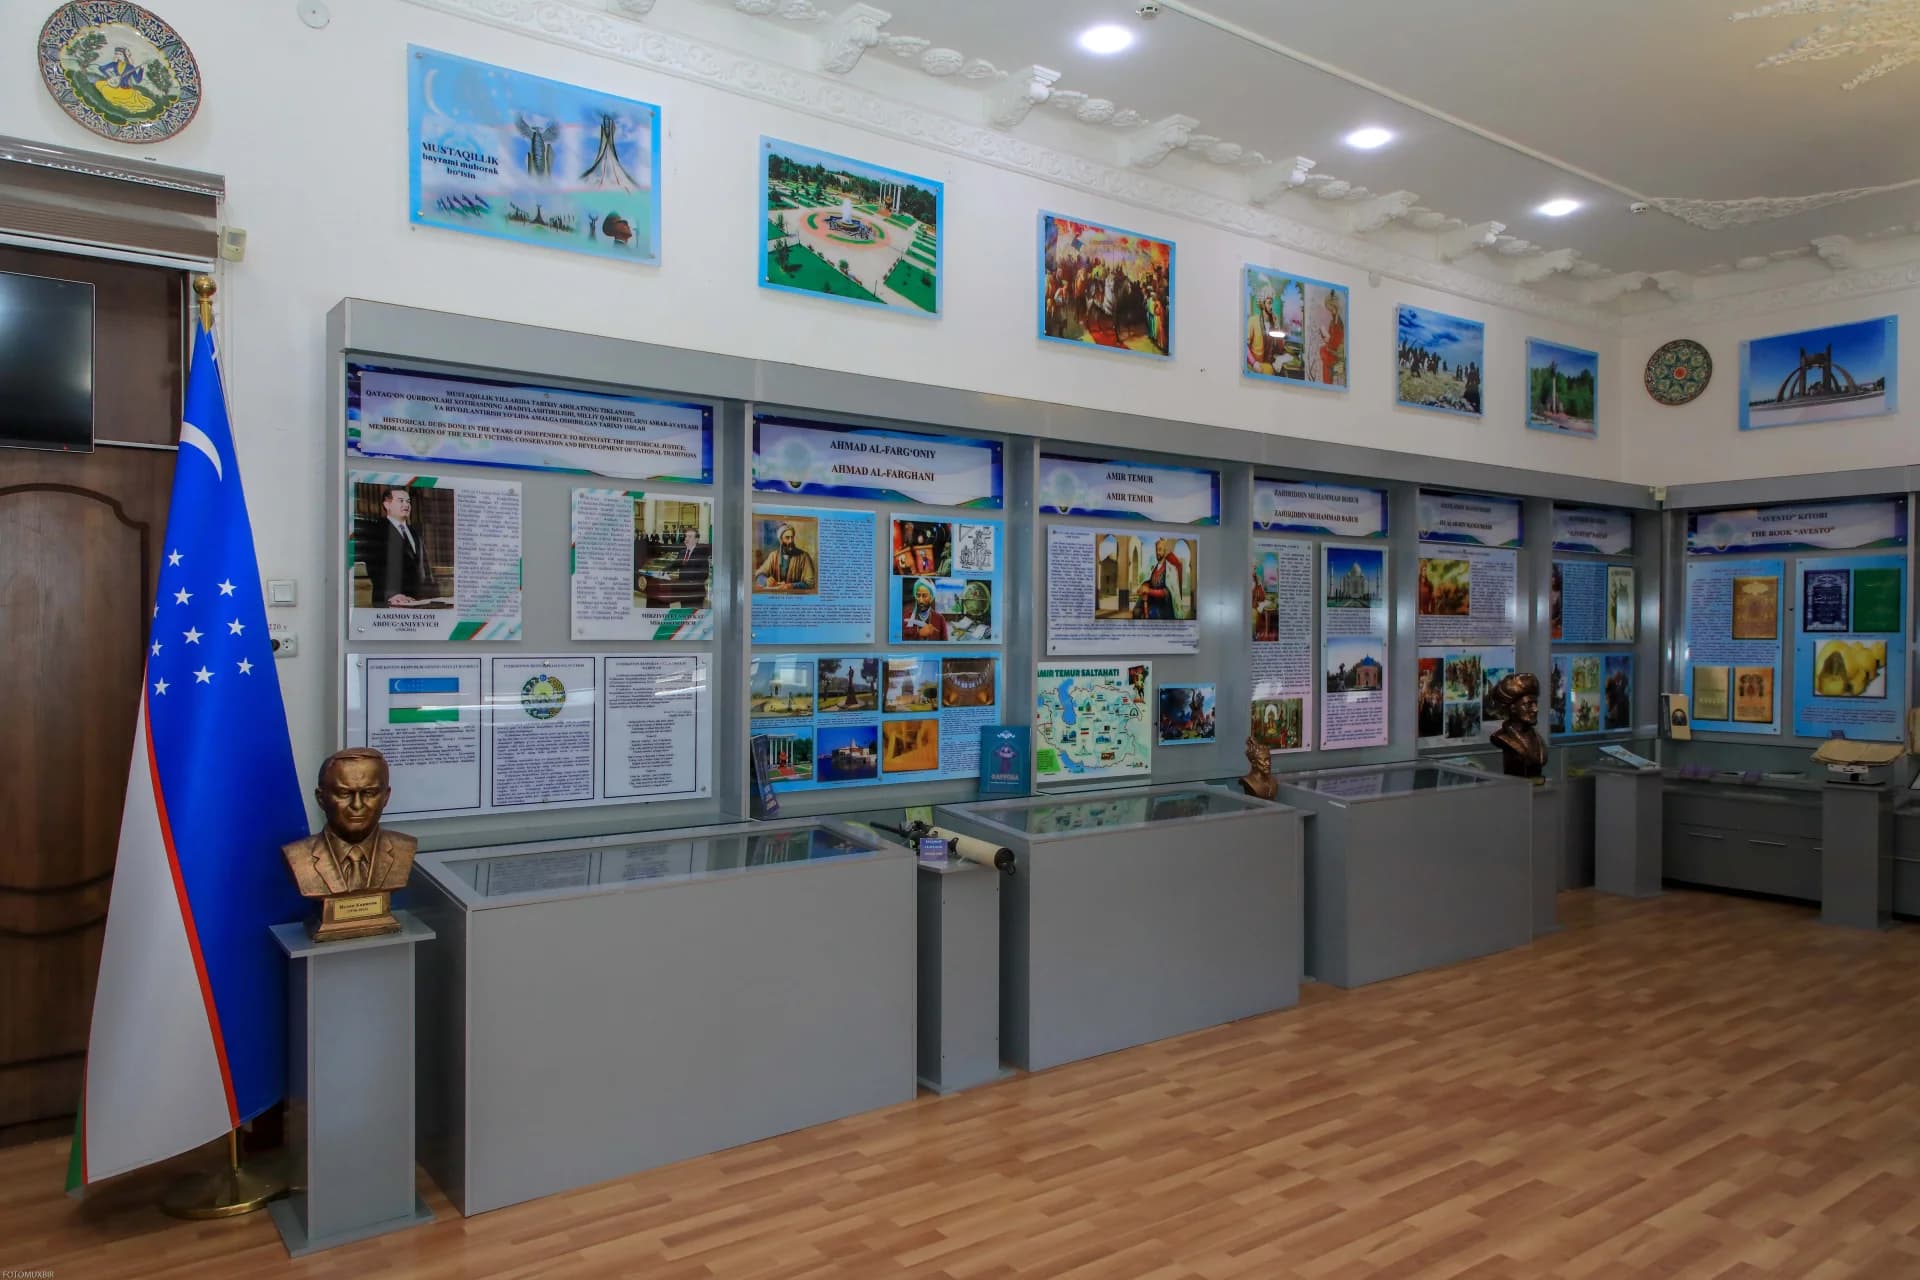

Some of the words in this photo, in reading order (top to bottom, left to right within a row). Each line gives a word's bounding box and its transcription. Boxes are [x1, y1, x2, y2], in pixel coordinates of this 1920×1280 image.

[422, 142, 500, 166] MUSTAQILLIK
[422, 152, 459, 167] bayrami
[460, 162, 499, 174] muborak
[406, 392, 452, 404] QURBONLARI
[446, 390, 494, 401] MUSTAQILLIK
[531, 415, 558, 423] AMALGA
[383, 417, 427, 426] HISTORICAL
[626, 440, 660, 449] HISTORICAL
[515, 437, 563, 447] CONSERVATION
[579, 443, 623, 452] DEVELOPMENT
[633, 448, 662, 456] NATIONAL
[830, 440, 867, 452] AHMAD
[832, 464, 869, 476] AHMAD
[870, 467, 934, 481] AL-FARGHANI
[1106, 472, 1126, 481] AMIR
[1128, 474, 1154, 483] TEMUR
[1107, 493, 1126, 501] AMIR
[1128, 494, 1154, 504] TEMUR
[1308, 493, 1341, 502] MUHAMMAD
[1307, 513, 1340, 522] MUHAMMAD
